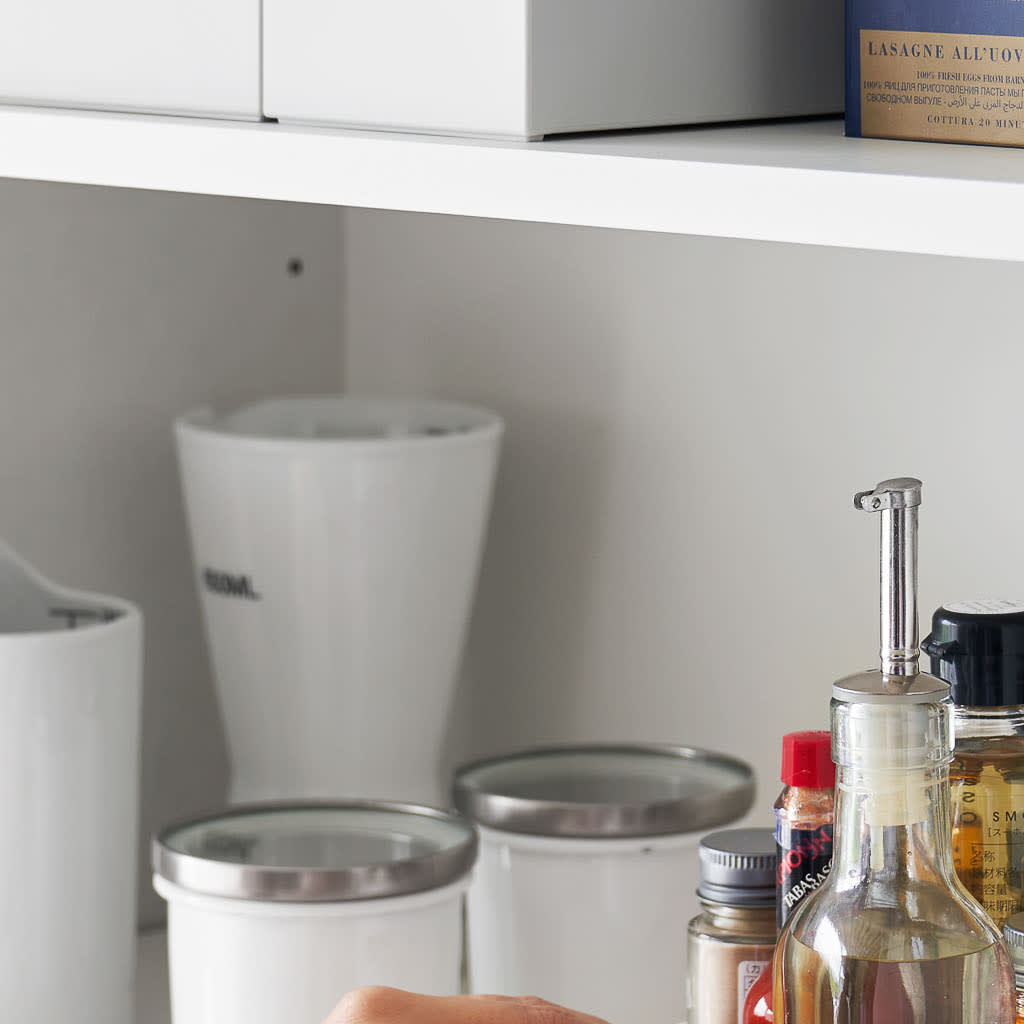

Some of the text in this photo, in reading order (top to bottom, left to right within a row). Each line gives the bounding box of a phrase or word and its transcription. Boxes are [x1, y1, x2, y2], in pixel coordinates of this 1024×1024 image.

[868, 41, 945, 60] LASAGNE
[937, 71, 960, 81] FRESH
[962, 73, 981, 82] EGGS
[983, 74, 1003, 84] FROM
[1005, 75, 1024, 85] BARN
[917, 83, 979, 95] ПРИГОТОВЛЕНИЯ
[980, 87, 1005, 97] ПАСТЫ
[1007, 89, 1019, 98] МЫ
[866, 93, 942, 106] СВОБОДНОМ ВЫГУЛЕ
[927, 115, 974, 126] COTTURA
[978, 118, 991, 127] 20
